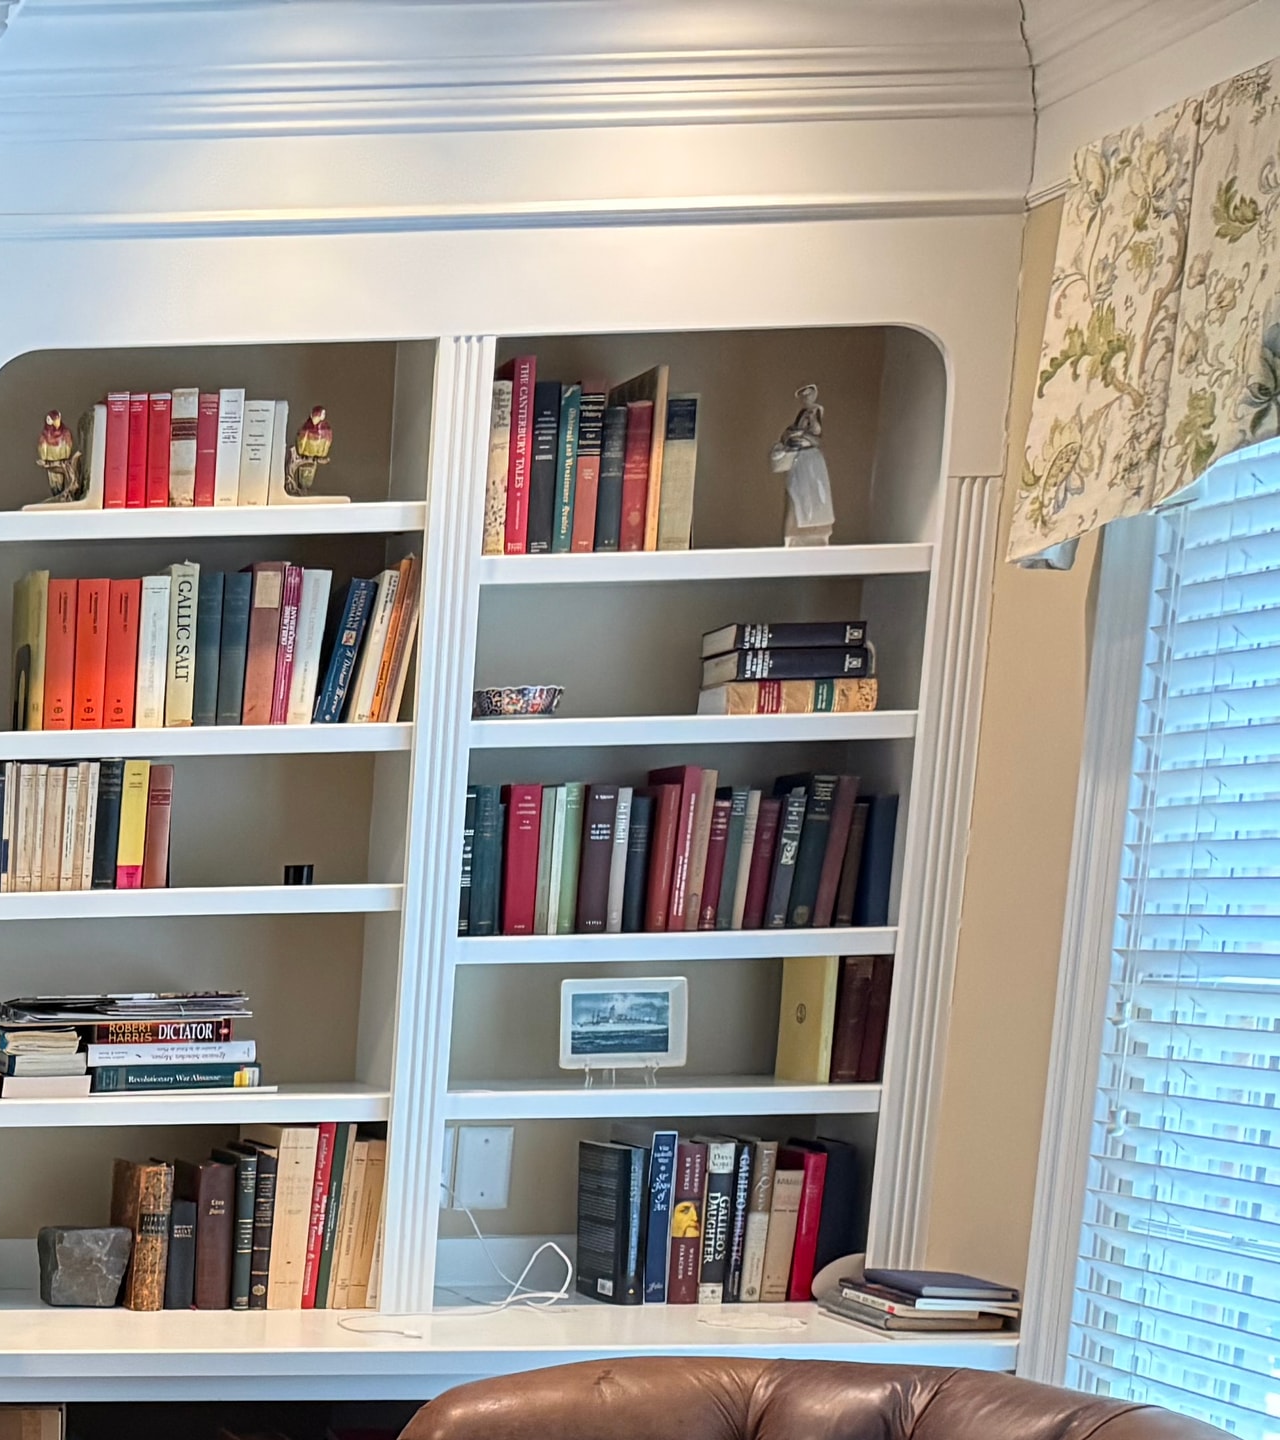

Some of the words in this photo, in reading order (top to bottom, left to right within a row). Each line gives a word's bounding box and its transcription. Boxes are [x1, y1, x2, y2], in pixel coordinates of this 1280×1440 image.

[520, 363, 530, 384] THE
[515, 386, 529, 455] CANTERBURY
[514, 457, 525, 489] TALES
[175, 579, 193, 641] GALLIC
[174, 643, 190, 683] SALT
[338, 659, 351, 687] Distant
[331, 686, 344, 714] Mirror
[108, 1022, 152, 1034] ROBERT
[108, 1032, 152, 1042] HARRIS
[158, 1023, 213, 1040] DICTATOR
[127, 1074, 175, 1084] Revolutionary
[176, 1074, 190, 1083] War
[191, 1073, 221, 1082] Almanac
[683, 1169, 692, 1191] VINCI
[692, 1154, 702, 1194] LEONARDO
[736, 1154, 751, 1209] GALILEO
[703, 1191, 721, 1265] DAUGHTER
[715, 1195, 731, 1261] GALILEO'S
[730, 1210, 745, 1266] HERETIC
